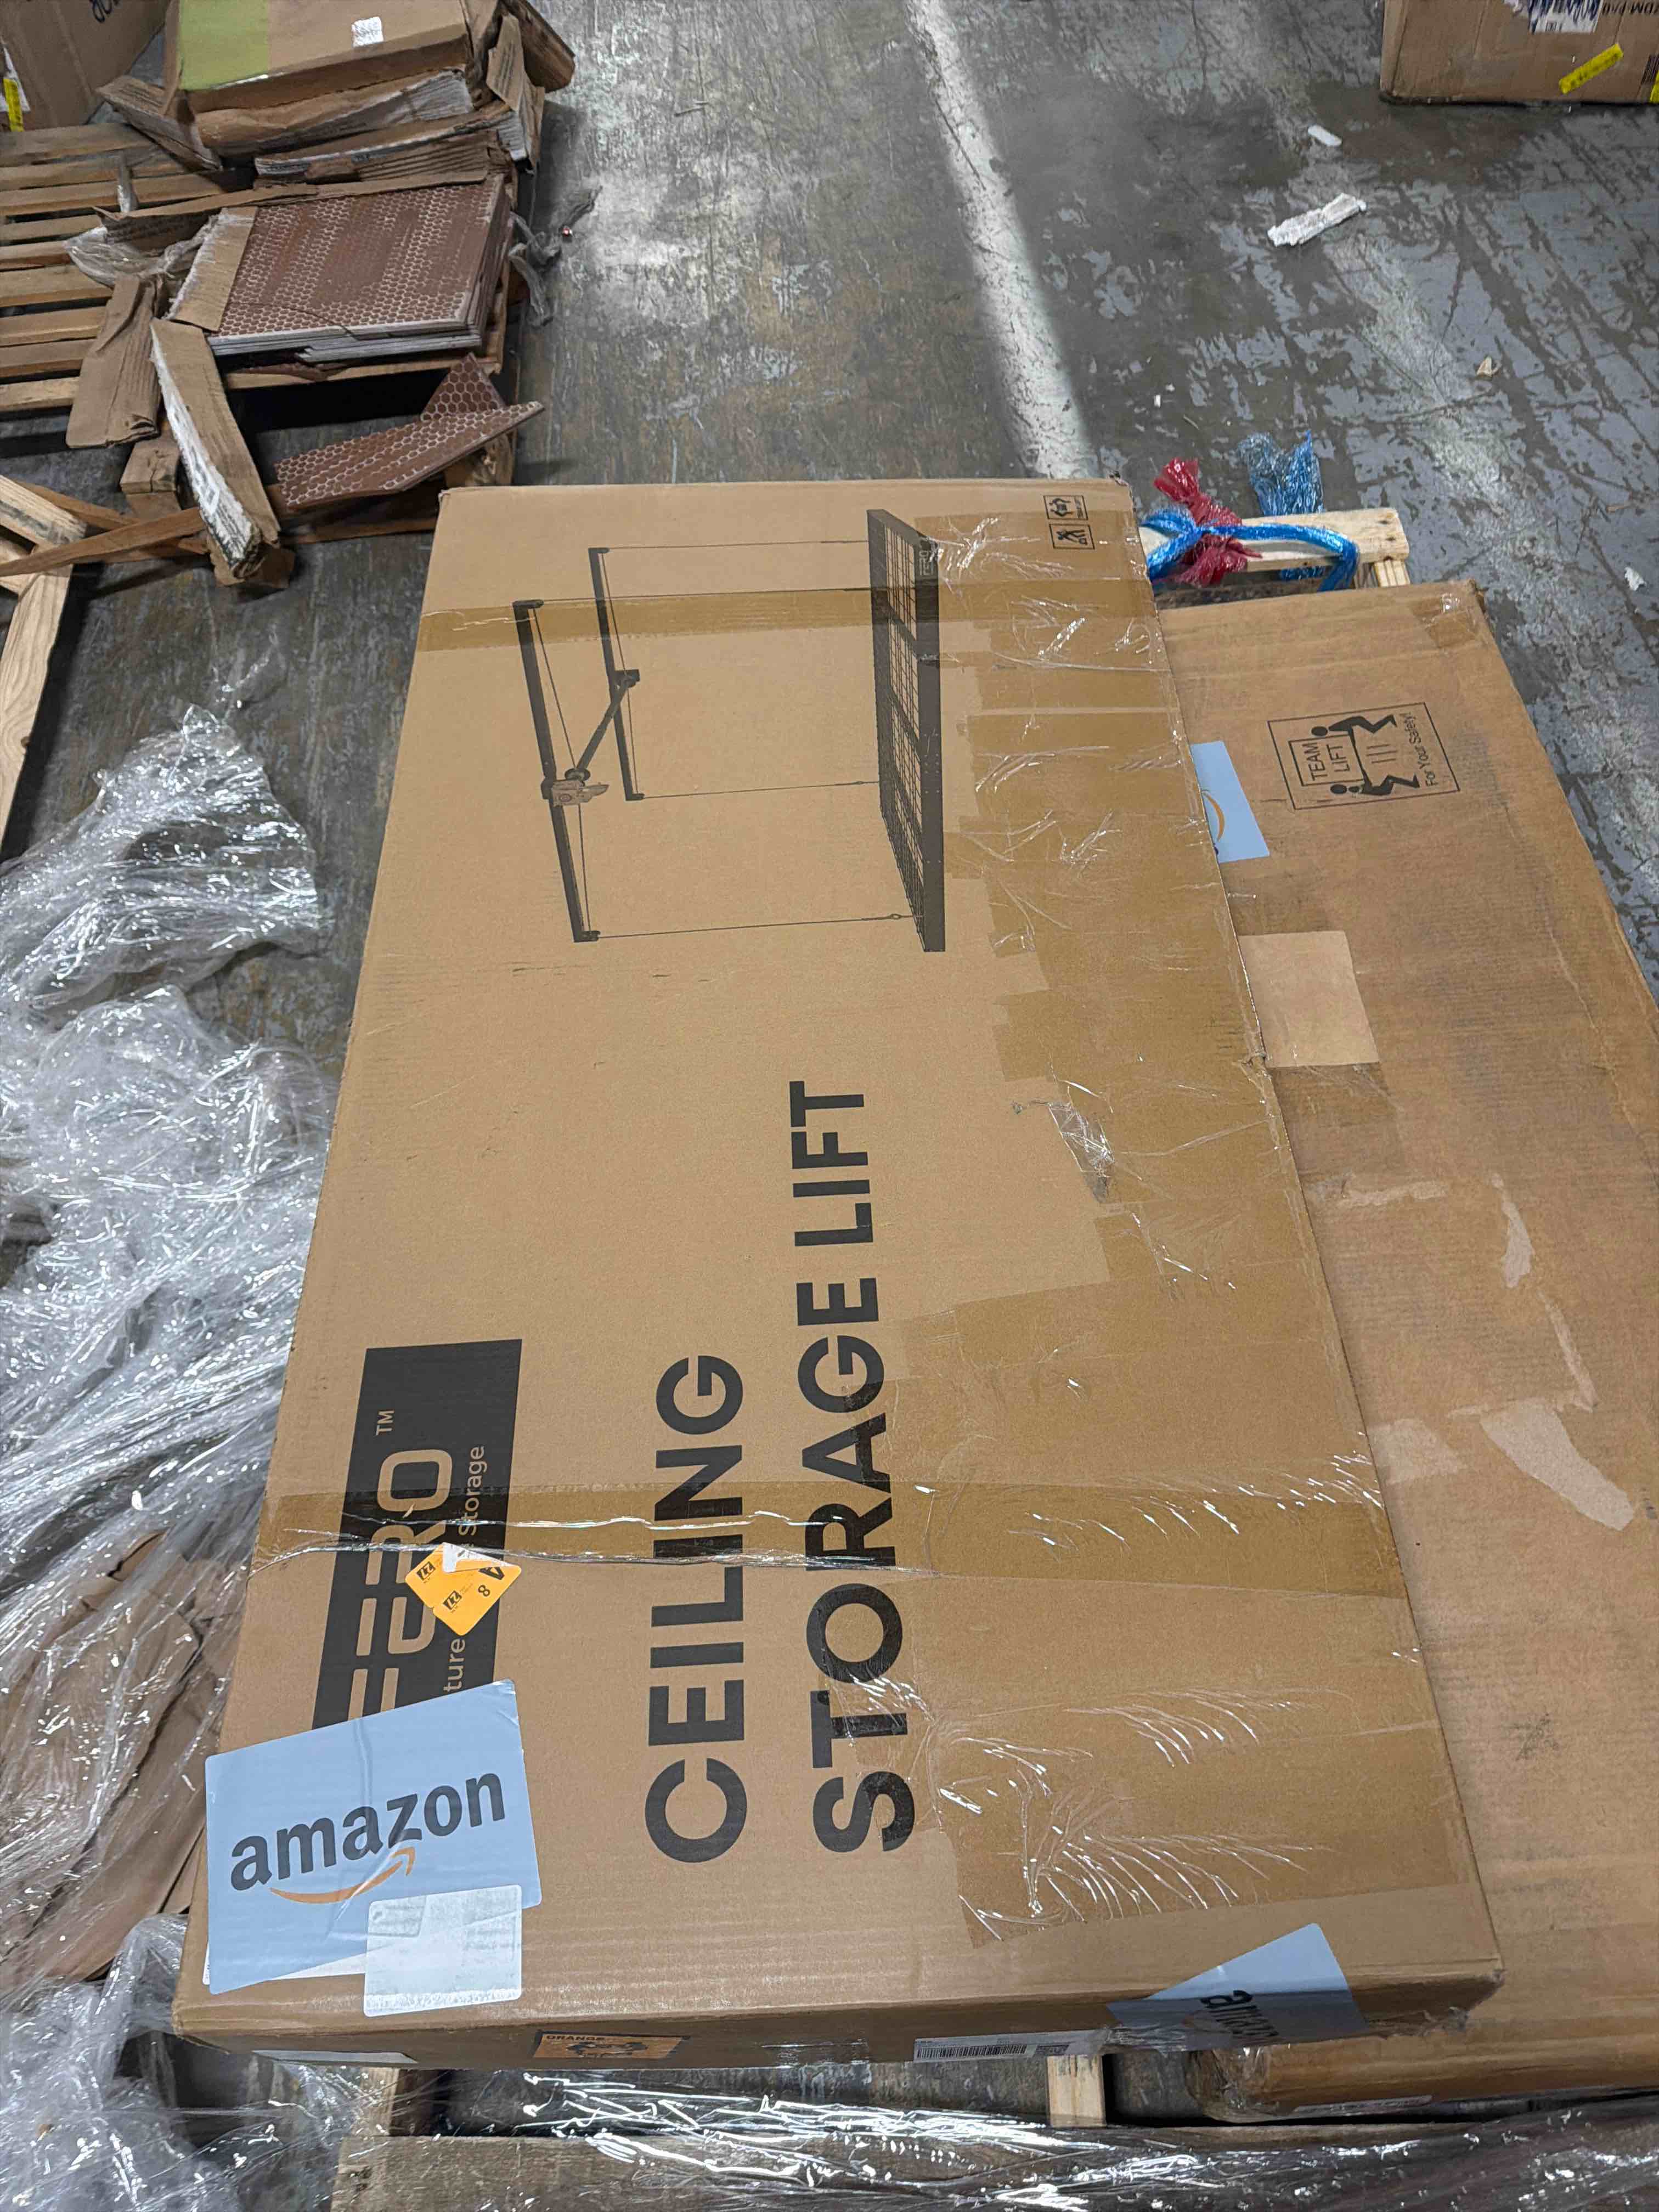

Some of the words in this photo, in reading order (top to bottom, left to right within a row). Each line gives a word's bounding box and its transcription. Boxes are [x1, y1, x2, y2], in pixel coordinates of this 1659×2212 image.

[1401, 712, 1421, 744] Safety!
[1302, 742, 1328, 781] TEAM
[1326, 744, 1350, 772] LIFT
[1415, 746, 1432, 769] Your
[1424, 770, 1438, 787] For
[789, 1081, 873, 1247] LIFT
[375, 1409, 394, 1436] TM
[443, 1639, 466, 1692] ture
[459, 1446, 487, 1536] Storage
[796, 1278, 915, 1852] STORAGE
[478, 1584, 490, 1597] 8
[645, 1355, 747, 1862] CEILING
[230, 1773, 505, 1891] amazon
